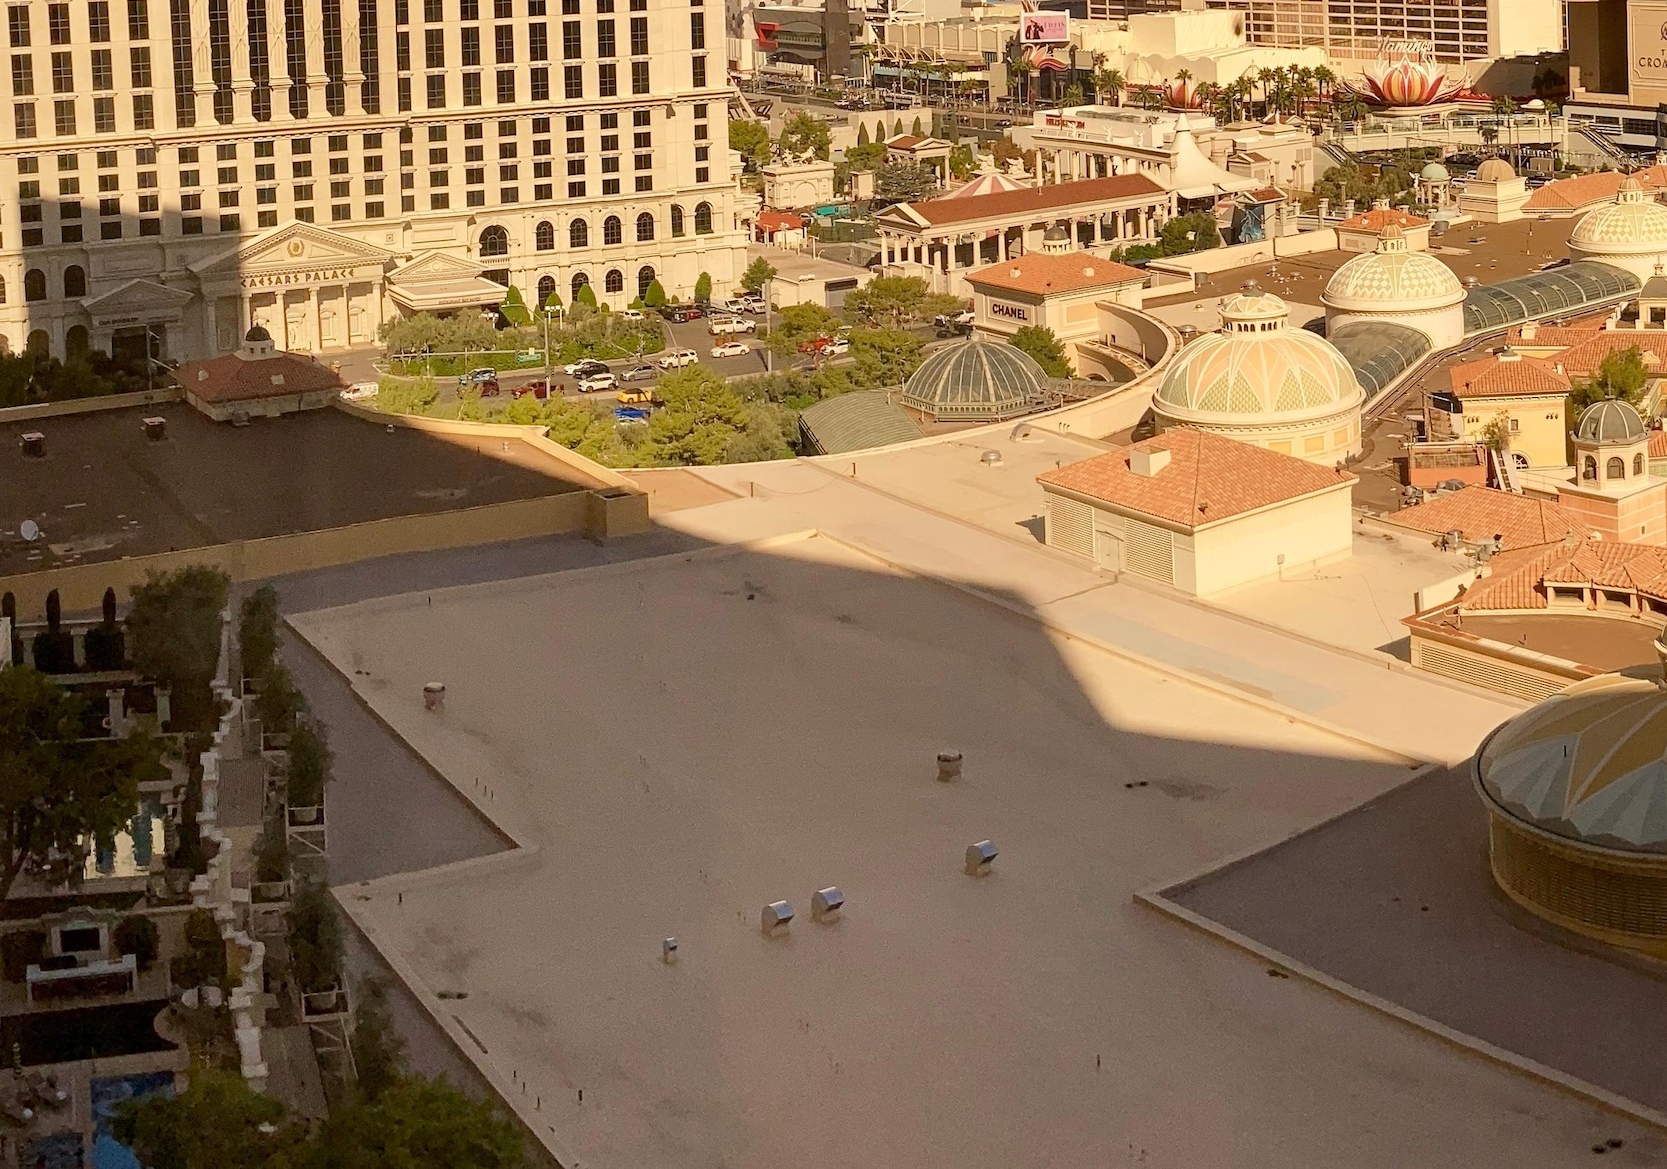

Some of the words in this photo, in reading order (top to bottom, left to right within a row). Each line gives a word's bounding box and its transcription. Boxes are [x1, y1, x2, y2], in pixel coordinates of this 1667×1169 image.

[1374, 34, 1434, 59] Flamingo
[240, 274, 300, 288] CAESARS
[305, 268, 355, 282] PALACE
[992, 303, 1028, 321] CHANEL
